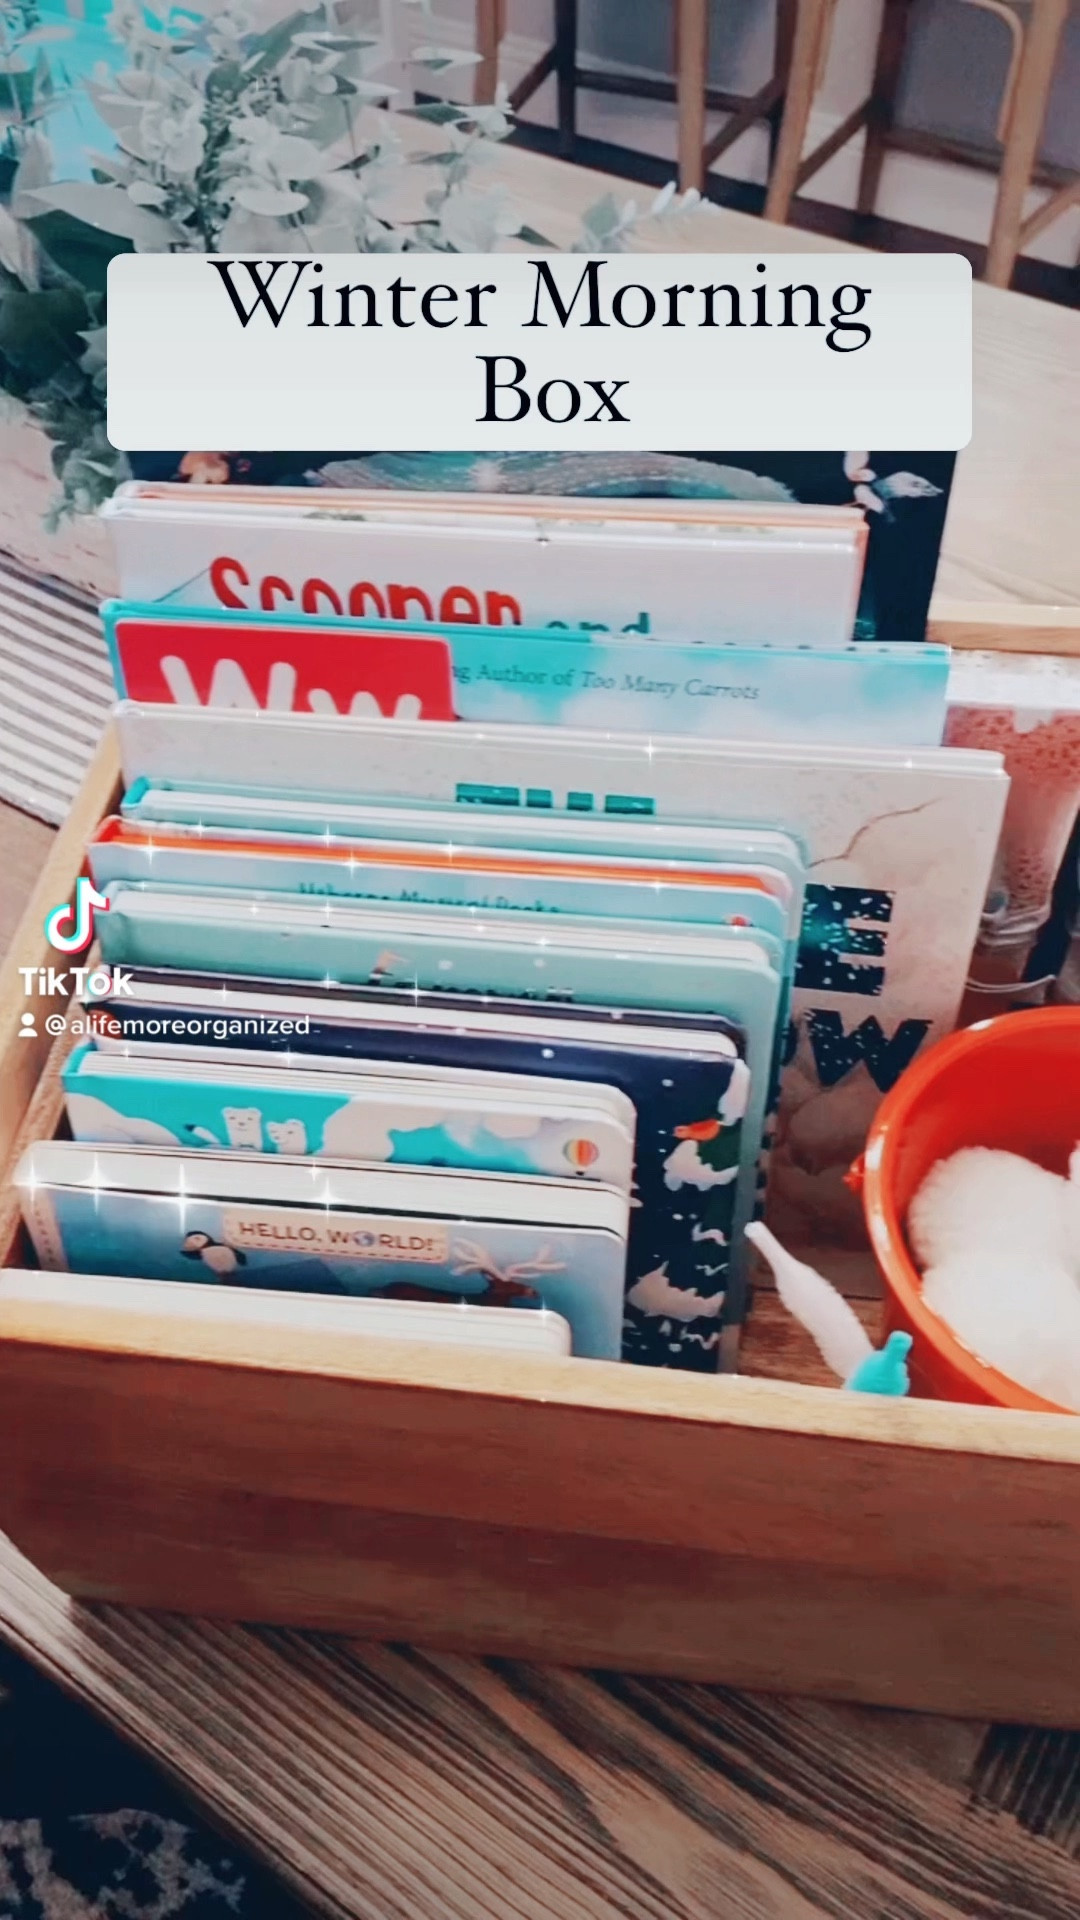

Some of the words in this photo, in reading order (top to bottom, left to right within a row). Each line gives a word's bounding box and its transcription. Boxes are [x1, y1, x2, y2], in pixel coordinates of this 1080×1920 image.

[476, 664, 549, 685] Author
[552, 669, 576, 687] of
[581, 671, 616, 689] Too
[620, 673, 678, 699] Many
[684, 678, 760, 700] Carrots
[239, 1222, 322, 1242] HELLO,
